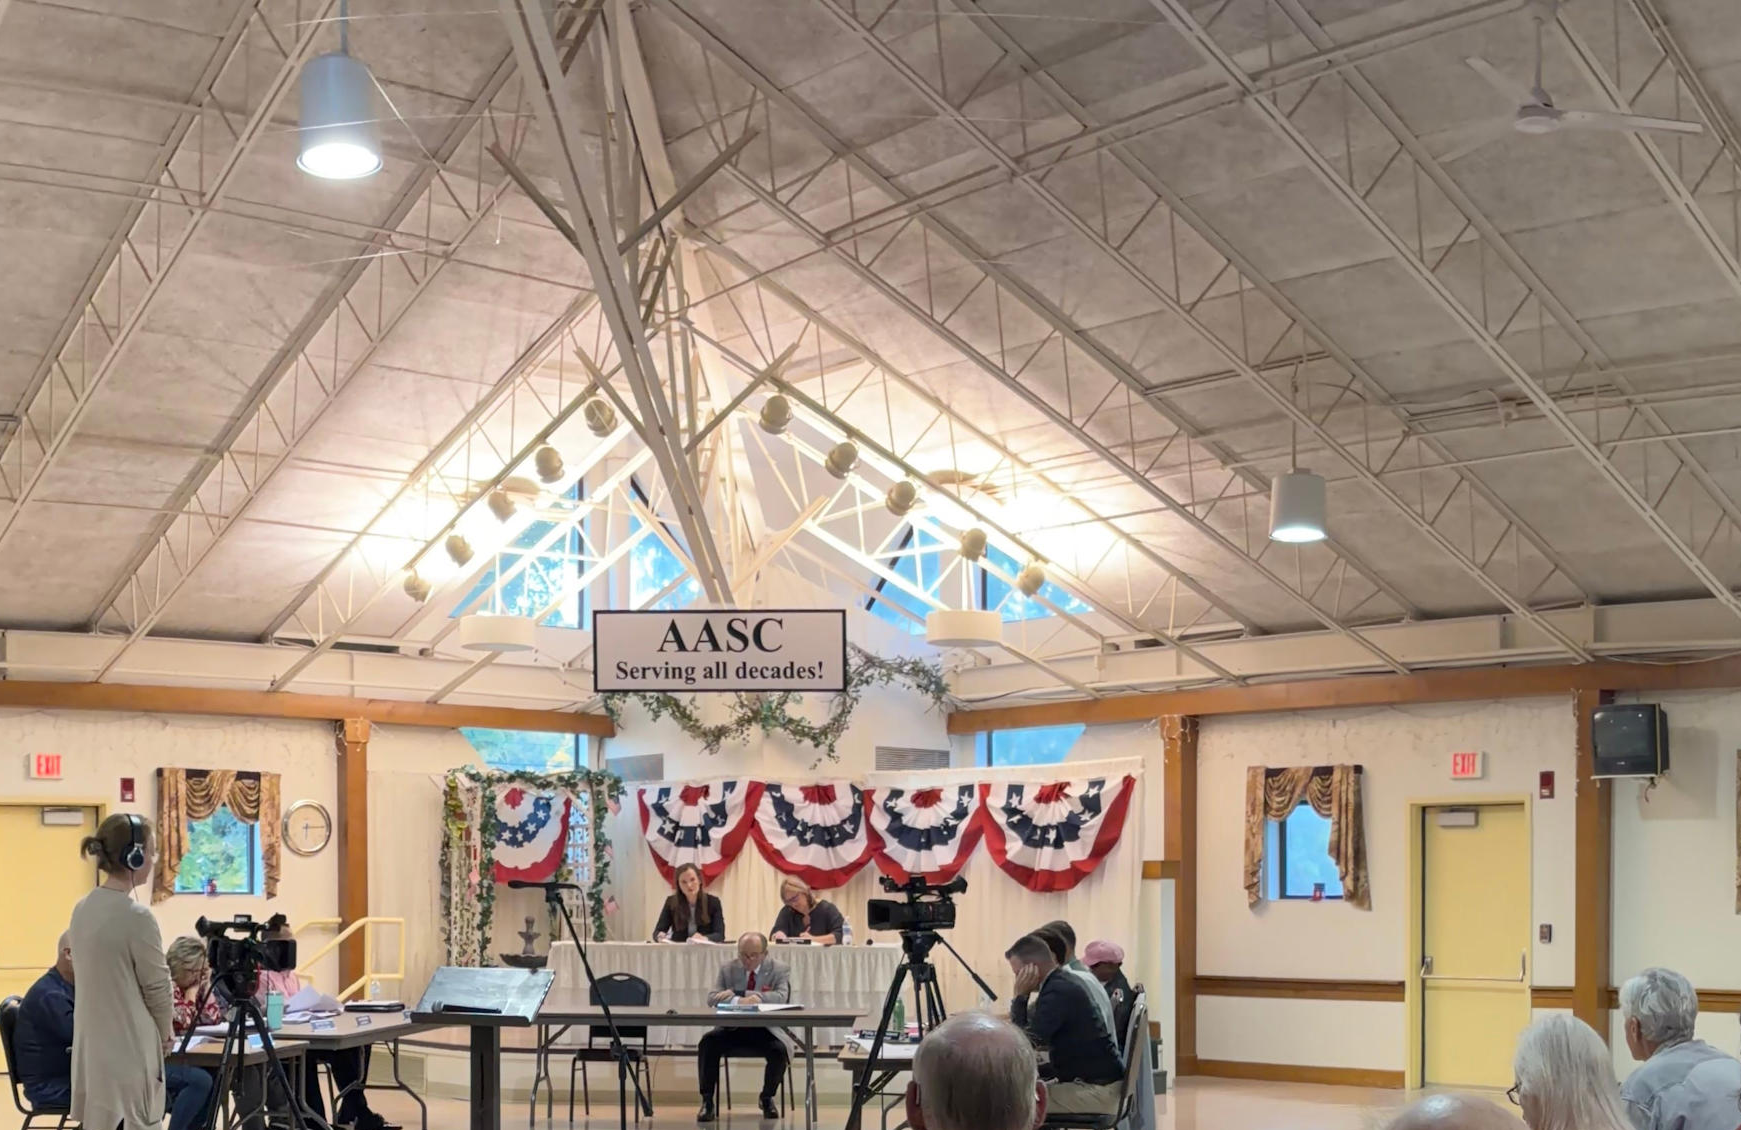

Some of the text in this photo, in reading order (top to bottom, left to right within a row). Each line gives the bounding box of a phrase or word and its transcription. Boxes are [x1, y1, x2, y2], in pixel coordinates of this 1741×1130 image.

[657, 617, 784, 653] AASC
[616, 661, 824, 684] Serving all decades!
[36, 754, 62, 776] EXIT
[1452, 753, 1477, 776] EXIT
